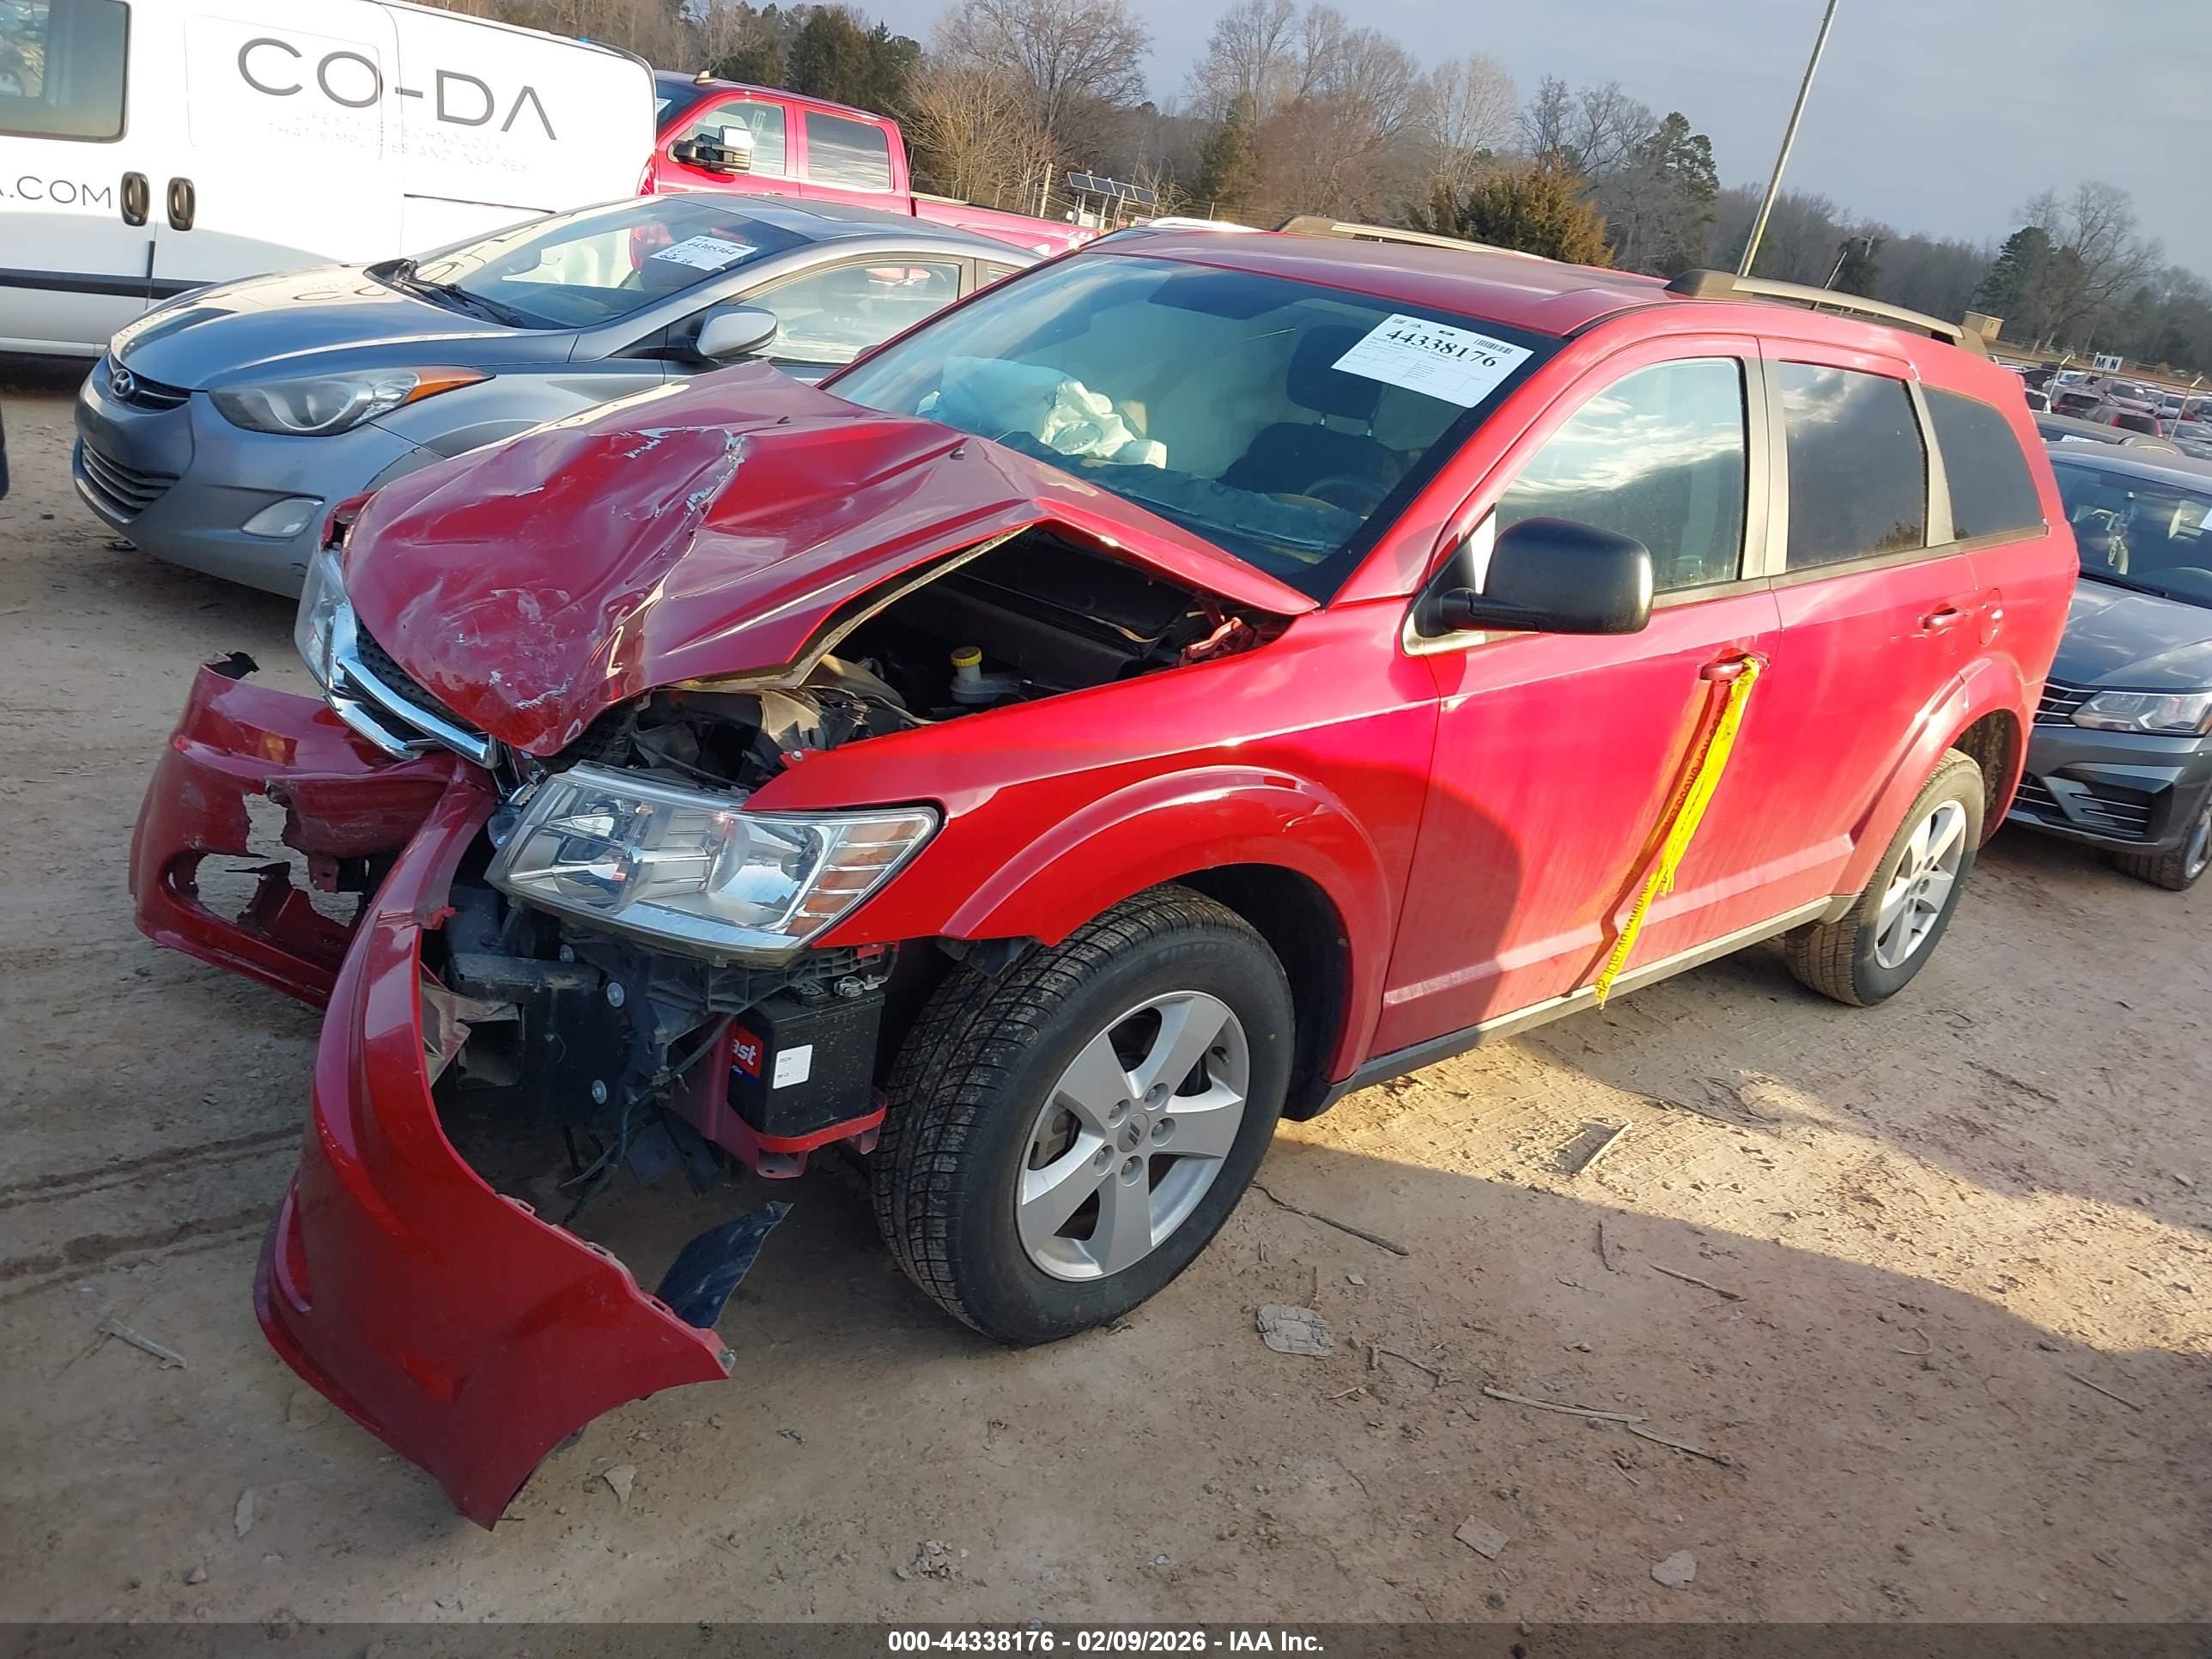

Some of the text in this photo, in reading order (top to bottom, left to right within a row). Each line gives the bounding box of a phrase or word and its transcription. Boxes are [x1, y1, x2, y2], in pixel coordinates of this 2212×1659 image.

[238, 37, 557, 141] CO-DA
[418, 143, 453, 161] AND
[1384, 329, 1503, 368] 44338176
